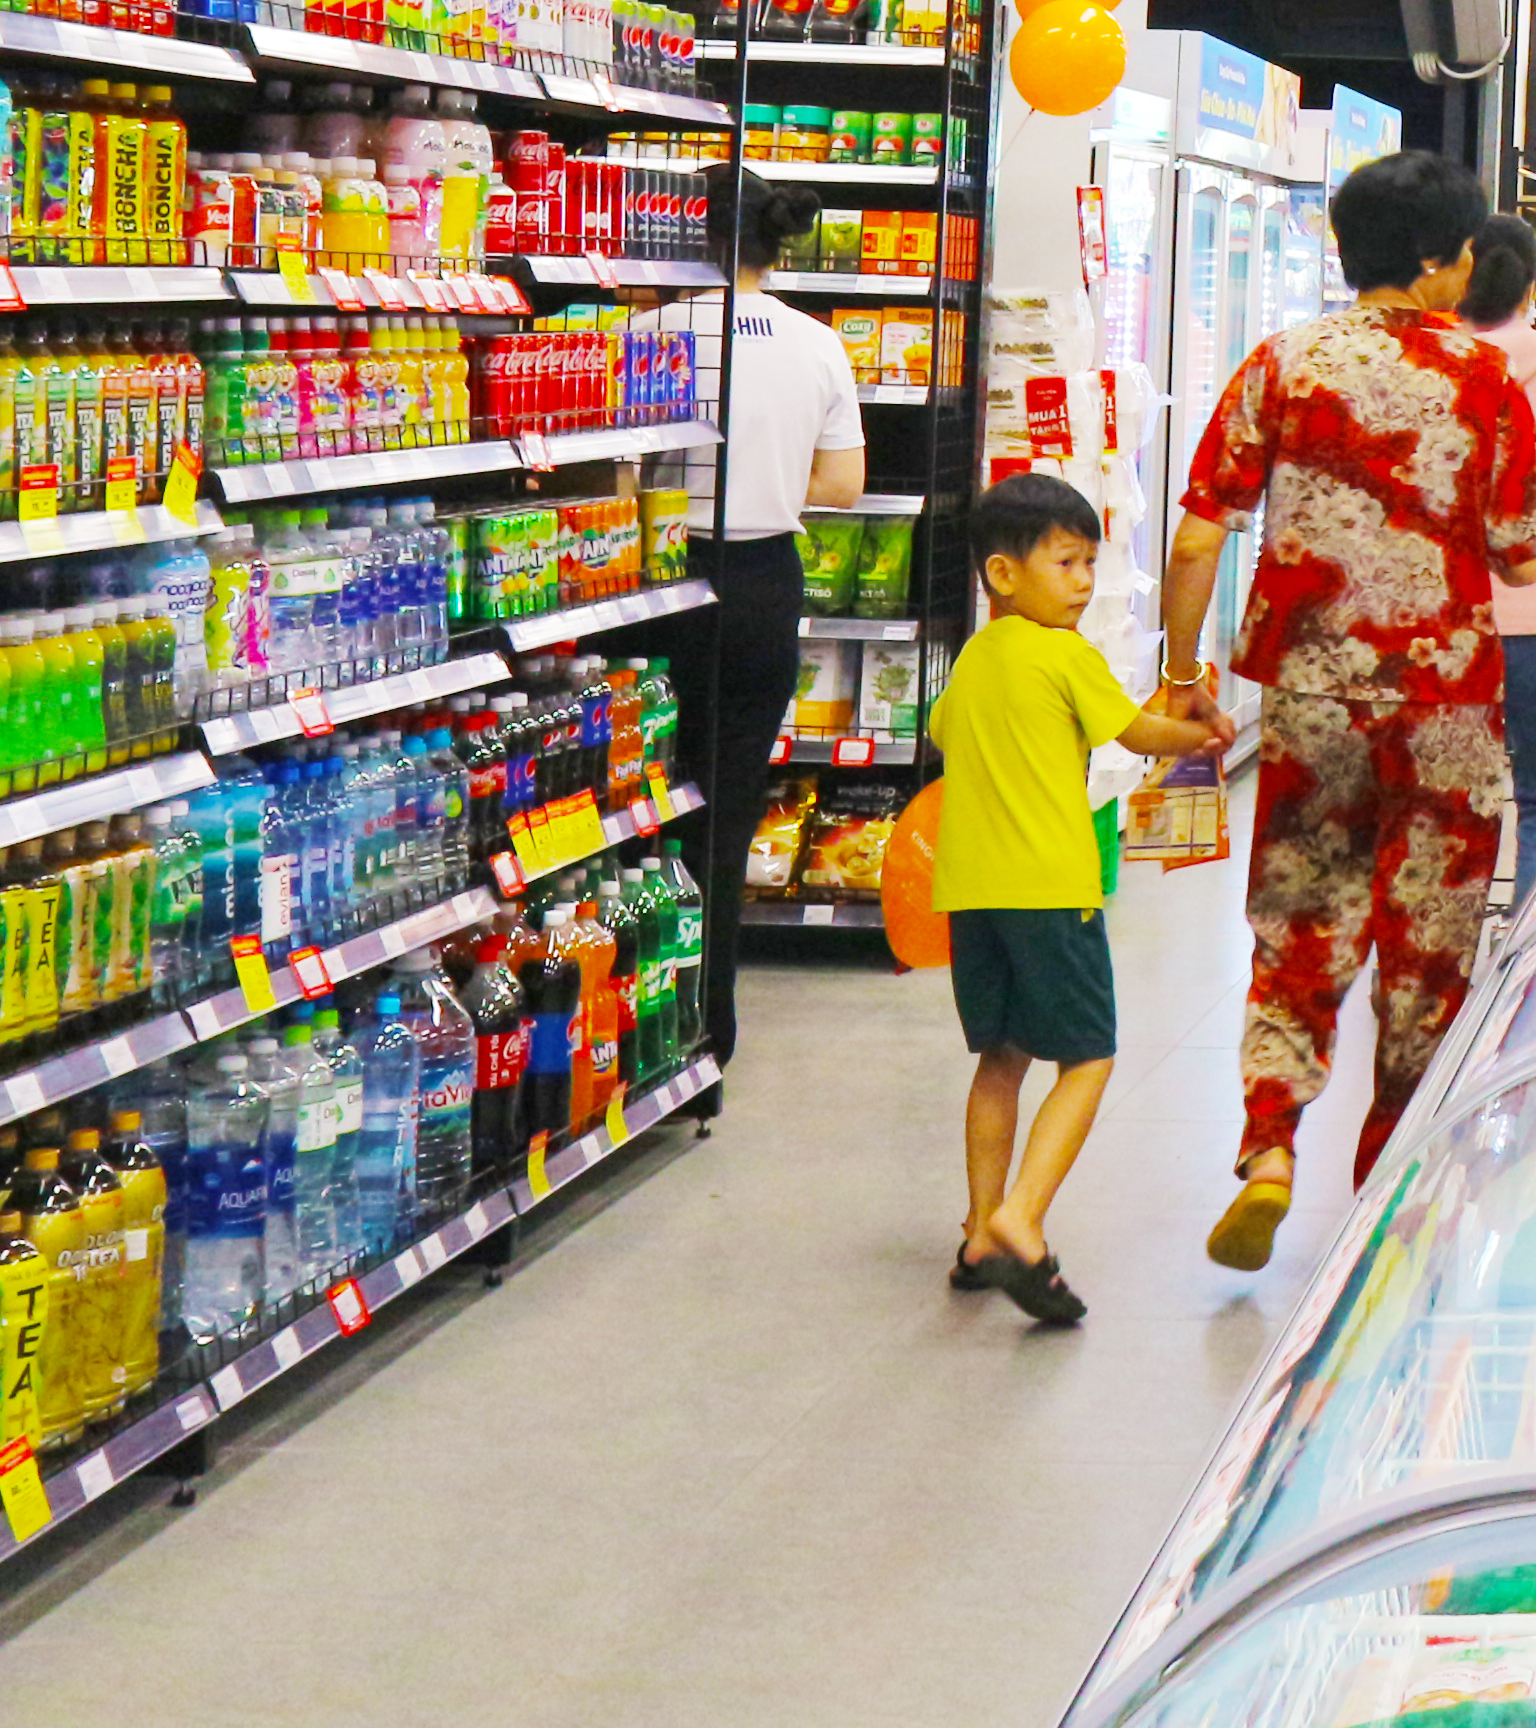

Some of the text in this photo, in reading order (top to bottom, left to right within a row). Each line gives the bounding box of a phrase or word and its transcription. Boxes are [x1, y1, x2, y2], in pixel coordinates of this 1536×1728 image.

[155, 135, 173, 233] BONCHA
[1059, 405, 1067, 418] 1
[1060, 420, 1068, 433] 1
